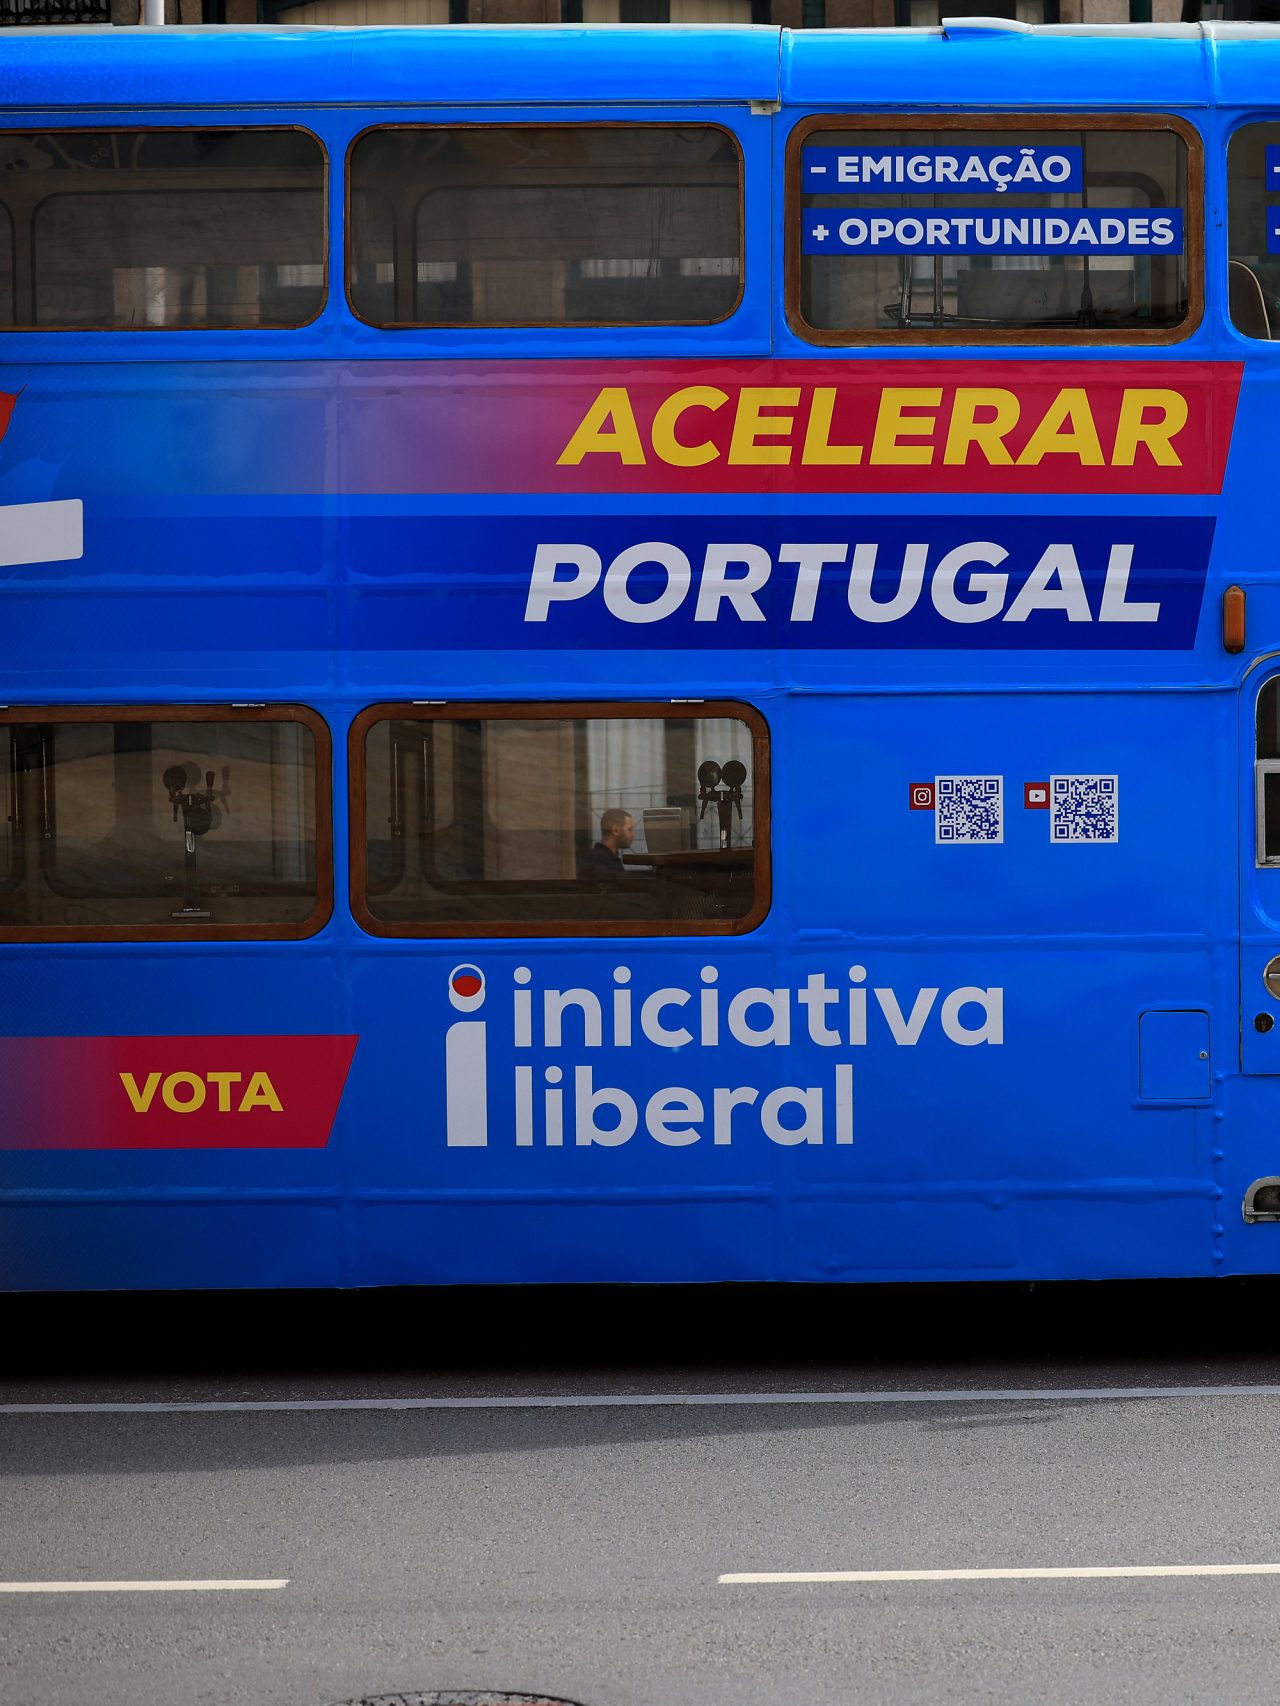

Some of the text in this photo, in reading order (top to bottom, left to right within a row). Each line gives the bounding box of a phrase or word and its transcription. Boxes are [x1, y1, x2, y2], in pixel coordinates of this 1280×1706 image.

[837, 149, 1071, 193] EMIGRAÇÃO
[838, 217, 1175, 246] OPORTUNIDADES
[556, 385, 1189, 467] ACELERAR
[523, 541, 1161, 624] PORTUGAL
[513, 964, 1004, 1048] iniciativa
[119, 1071, 284, 1113] VOTA
[514, 1063, 854, 1147] liberal
